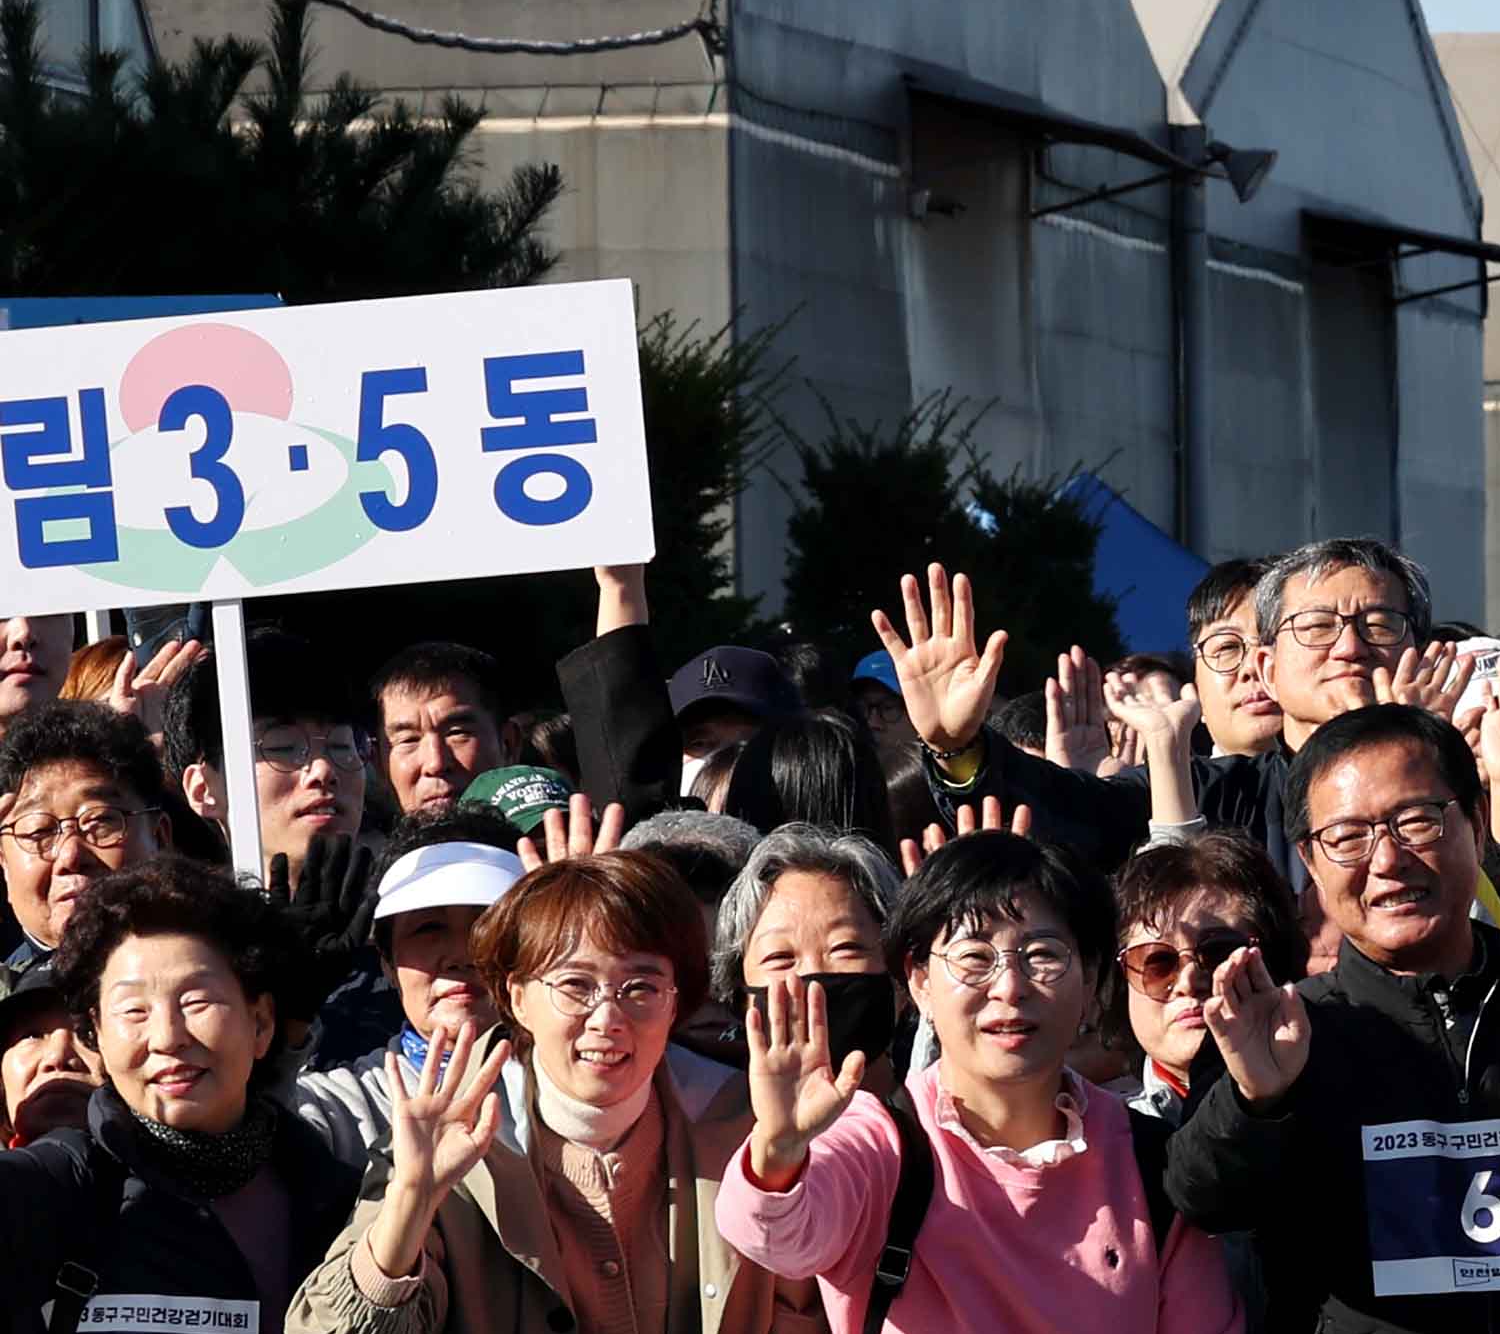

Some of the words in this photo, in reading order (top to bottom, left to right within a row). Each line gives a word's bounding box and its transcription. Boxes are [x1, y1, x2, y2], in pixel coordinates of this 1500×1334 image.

[1374, 1132, 1419, 1152] 2023
[92, 1307, 118, 1323] 동구
[120, 1307, 249, 1329] 구민건강걷기대회
